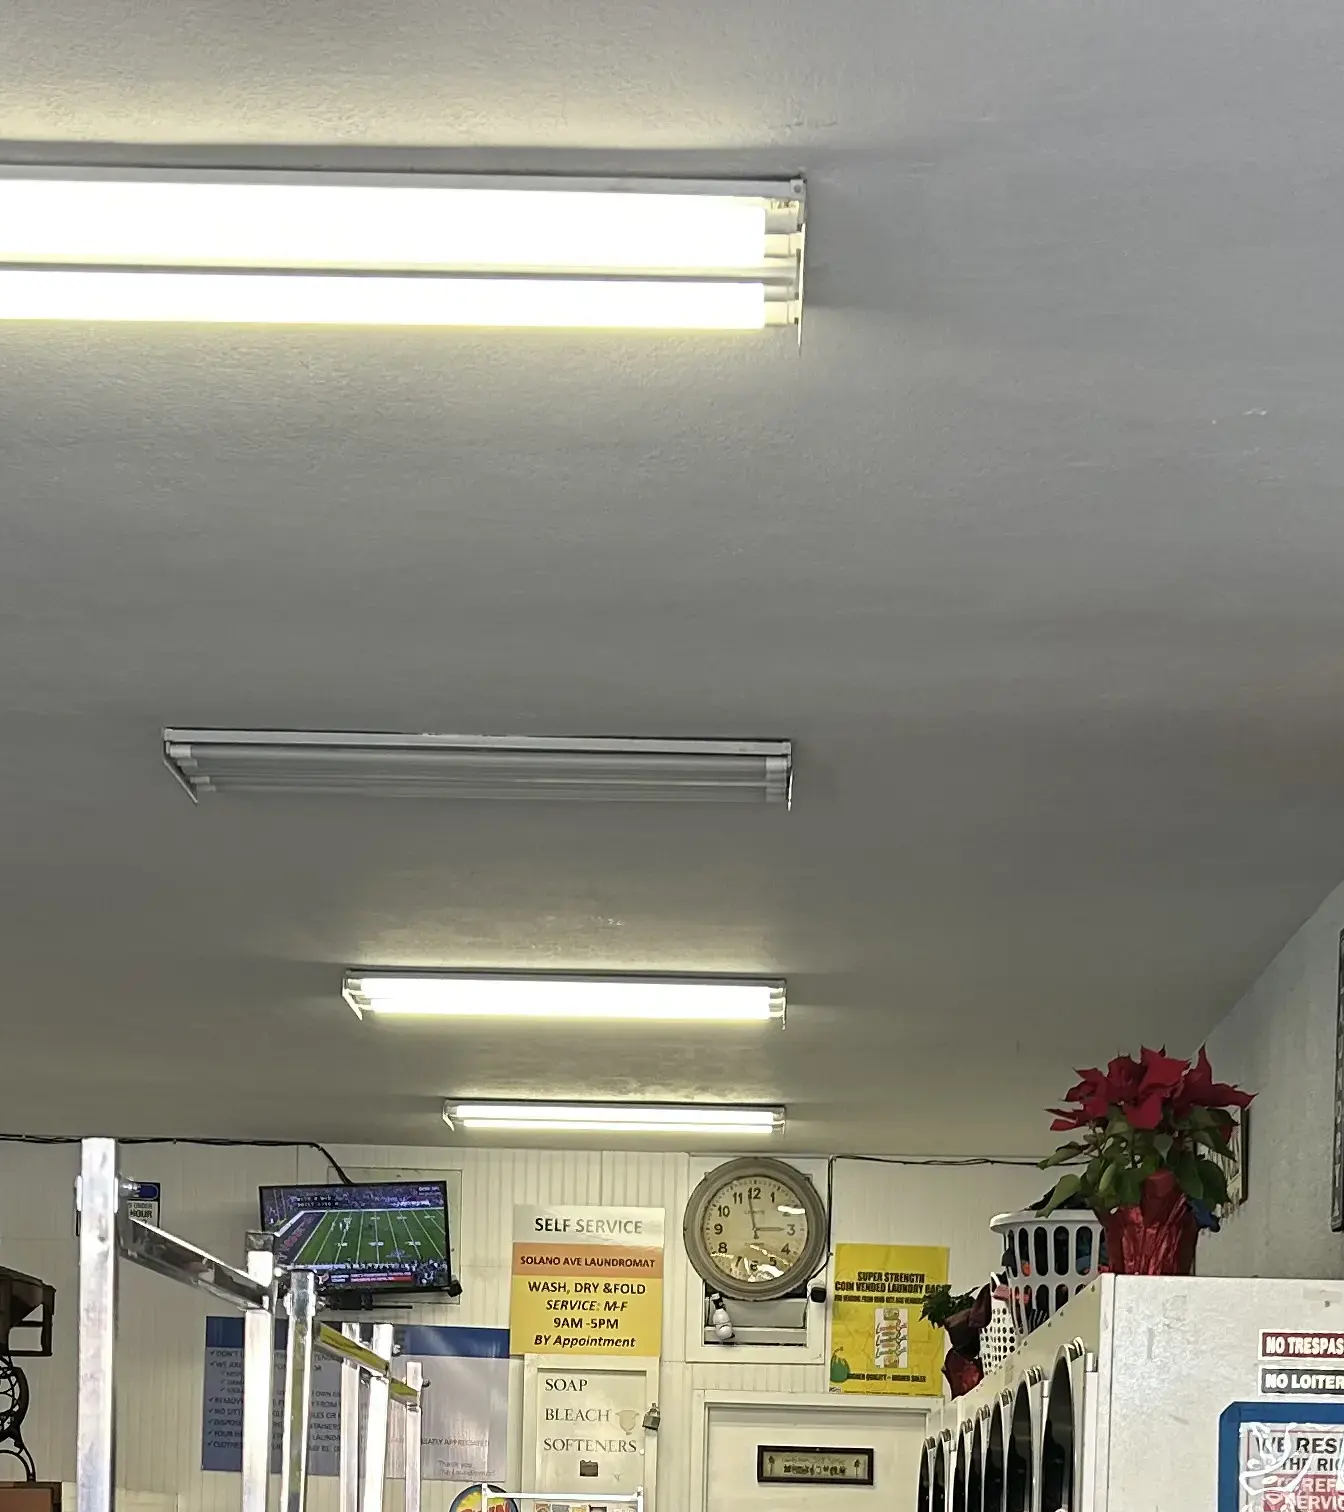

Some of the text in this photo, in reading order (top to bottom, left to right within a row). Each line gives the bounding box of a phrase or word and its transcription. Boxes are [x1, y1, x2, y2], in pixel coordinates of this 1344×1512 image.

[733, 1191, 743, 1205] 11
[747, 1187, 762, 1201] 12
[770, 1191, 775, 1203] 1
[717, 1205, 731, 1218] 10
[534, 1217, 643, 1234] SELF SERVICE
[713, 1223, 724, 1235] 9
[786, 1223, 796, 1236] 3
[717, 1242, 728, 1254] 8
[781, 1243, 791, 1255] 4
[520, 1255, 656, 1268] SOLANO AVE LAUNDROMAT
[857, 1271, 925, 1283] SUPER STRENGTH
[528, 1281, 646, 1295] WASH, DRY &FOLD
[546, 1300, 628, 1312] SERVICE: M-F
[553, 1317, 619, 1329] 9AM -5PM
[534, 1335, 636, 1348] BY Appointment
[1266, 1336, 1285, 1355] NO
[544, 1379, 588, 1391] SOAP
[1265, 1373, 1288, 1388] NO
[544, 1407, 611, 1422] BLEACH
[543, 1438, 637, 1453] SOFTENERS
